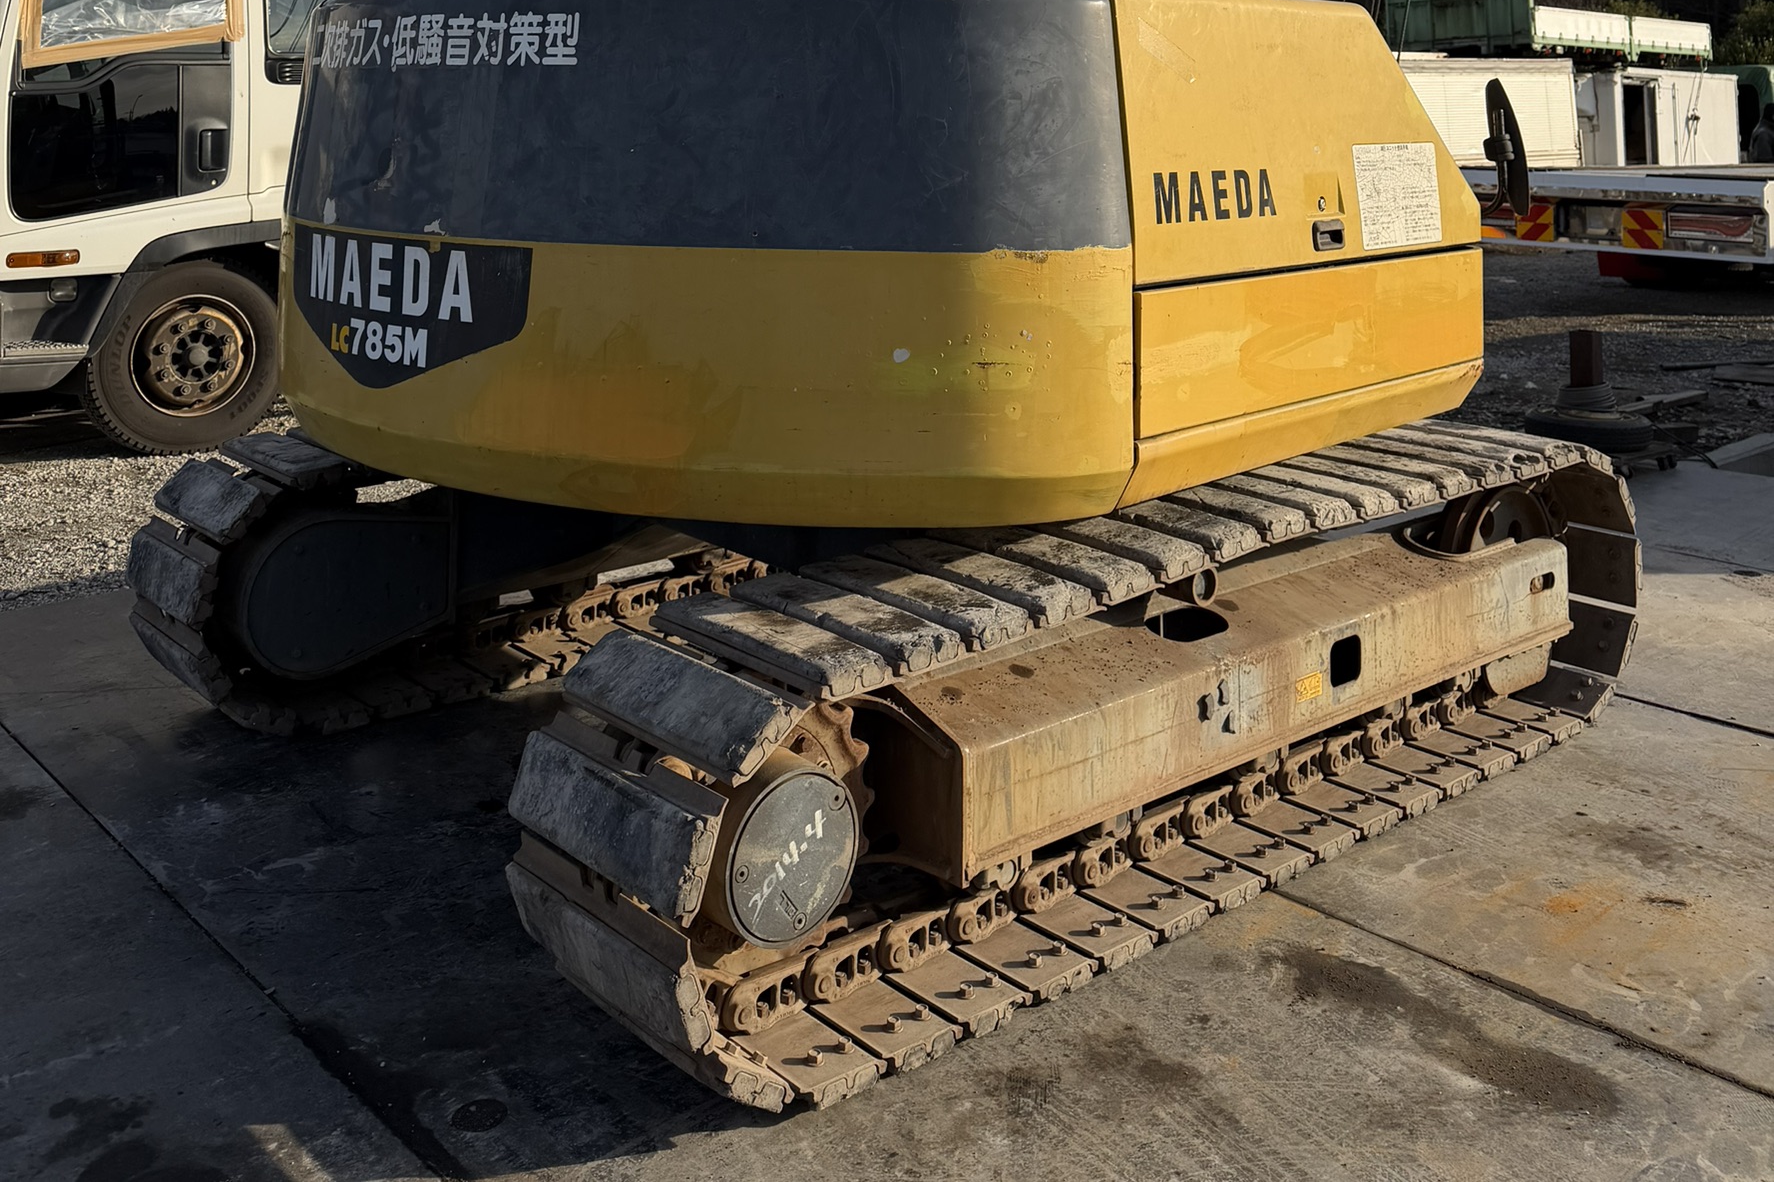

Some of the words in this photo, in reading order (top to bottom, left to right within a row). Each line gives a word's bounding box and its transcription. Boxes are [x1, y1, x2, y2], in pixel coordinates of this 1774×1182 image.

[1153, 168, 1278, 225] MAEDA
[309, 233, 474, 323] MAEDA
[107, 314, 135, 412] DUNLOP
[330, 317, 428, 368] LC785M
